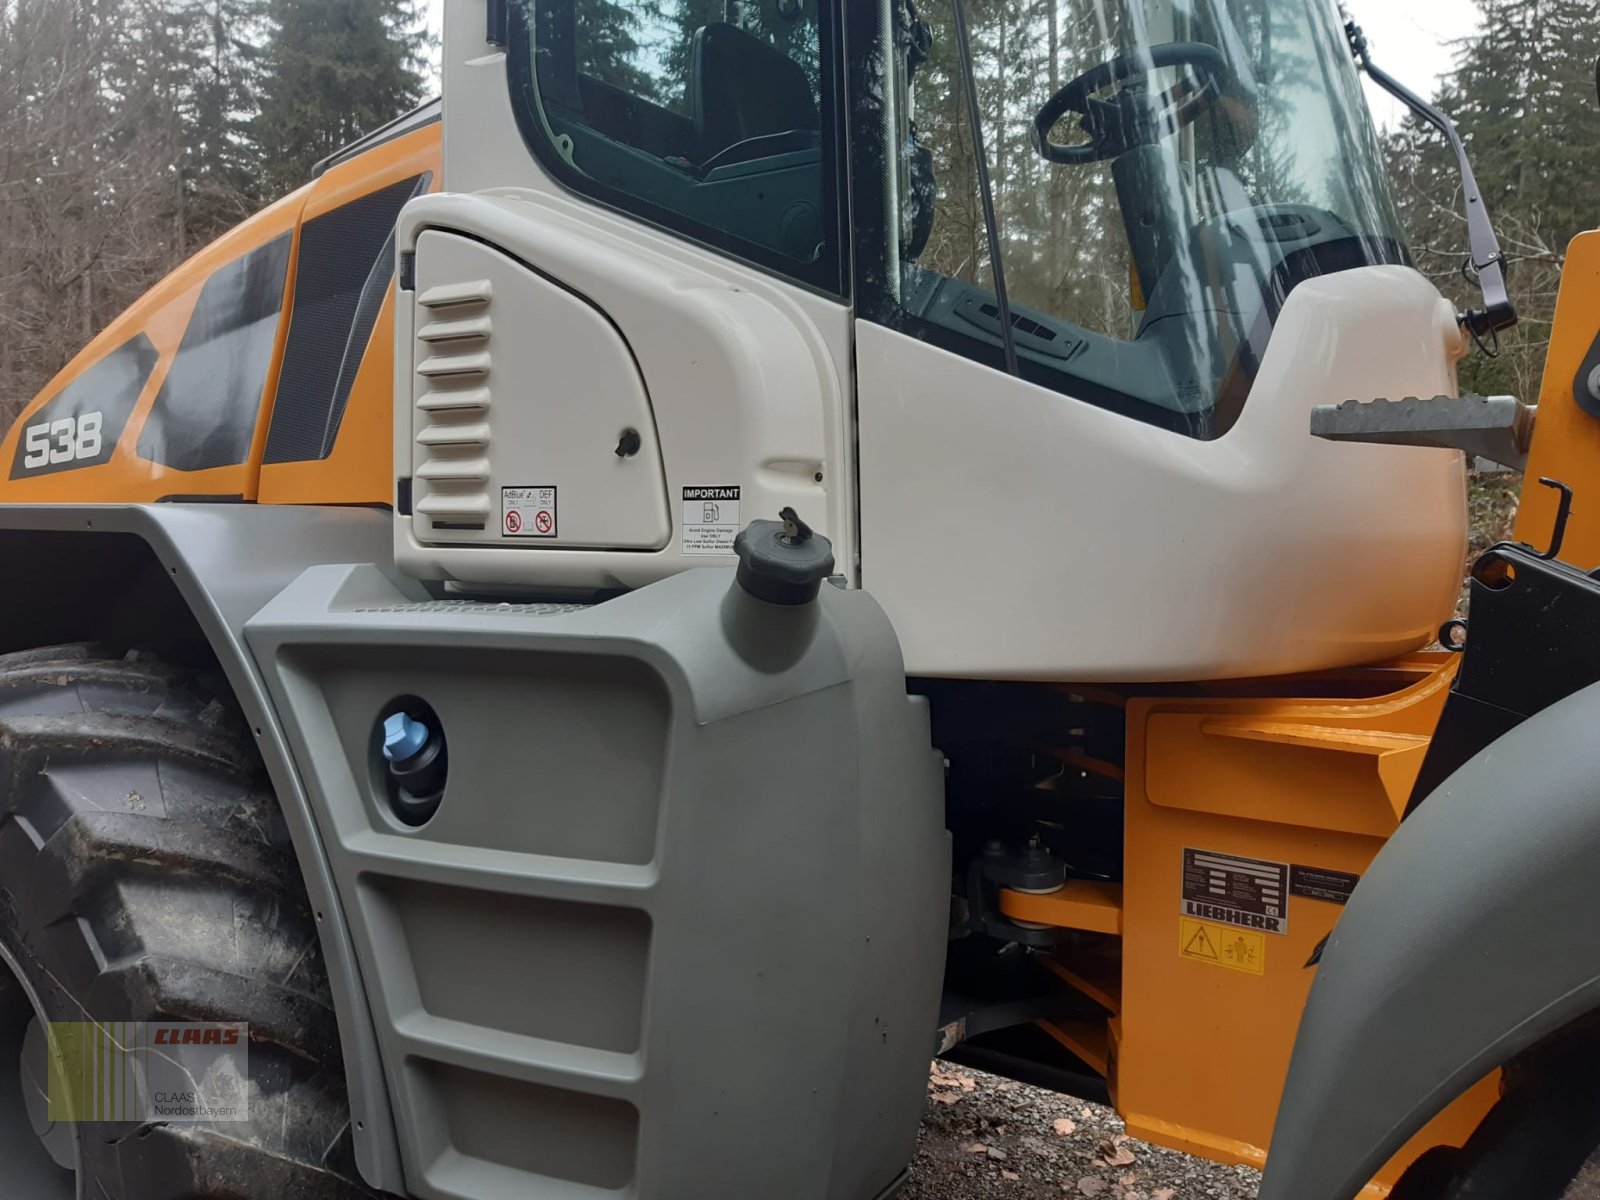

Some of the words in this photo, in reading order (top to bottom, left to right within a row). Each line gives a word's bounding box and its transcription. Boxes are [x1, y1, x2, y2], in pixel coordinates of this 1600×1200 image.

[24, 411, 102, 469] 538
[540, 490, 553, 499] DEF
[684, 489, 739, 498] IMPORTANT
[1186, 901, 1280, 932] LIEBHERR
